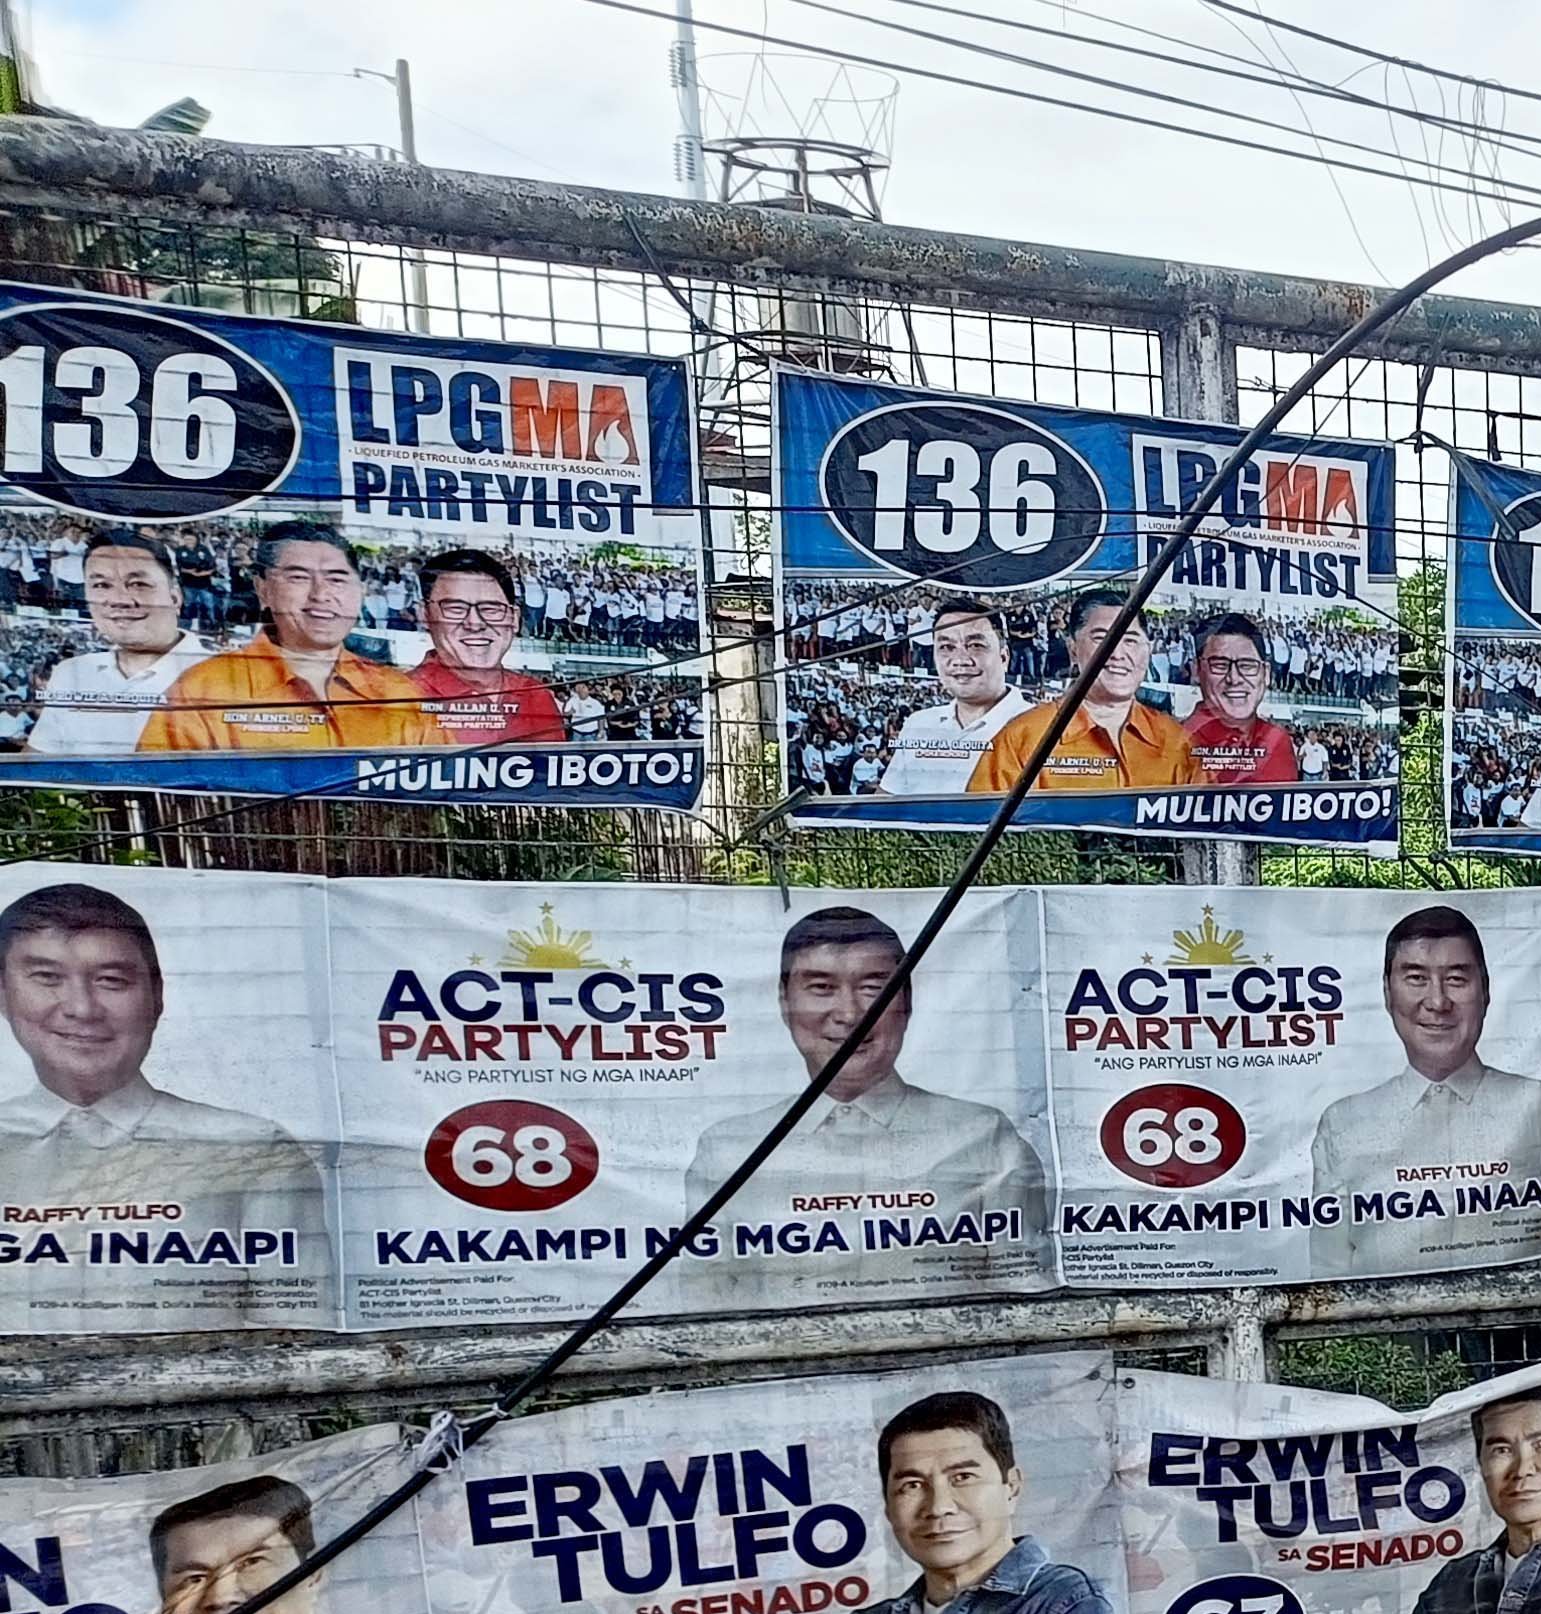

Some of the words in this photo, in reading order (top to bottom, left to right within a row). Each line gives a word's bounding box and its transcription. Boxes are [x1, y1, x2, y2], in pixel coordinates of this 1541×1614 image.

[0, 344, 239, 481] 136
[347, 358, 640, 466] LPGMA
[354, 447, 410, 460] LIQUEFIED
[413, 452, 477, 465] PETROLEUM
[479, 458, 500, 468] GAS
[502, 459, 567, 473] MARKETER'S
[568, 464, 636, 478] ASSOCIATION
[352, 461, 641, 535] PARTYLIST
[857, 439, 1058, 555] 136
[1142, 445, 1360, 540] LPGMA
[357, 753, 535, 793] MULING
[547, 752, 694, 789] IBOTO!
[1136, 791, 1273, 825] MULING
[1283, 788, 1390, 821] IBOTO!
[378, 969, 724, 1023] ACT-CIS
[1066, 966, 1341, 1017] ACT-CIS
[378, 1023, 727, 1062] PARTYLIST
[1066, 1013, 1344, 1052] PARTYLIST
[468, 1069, 553, 1083] PARTYLIST
[560, 1069, 587, 1082] NG
[592, 1069, 634, 1082] MGA
[1140, 1056, 1212, 1070] PARTYLIST
[1217, 1055, 1239, 1068] NG
[1243, 1055, 1274, 1067] MGA
[451, 1125, 570, 1188] 68
[1123, 1107, 1222, 1166] 68
[1397, 1167, 1452, 1182] RAFFY
[1457, 1162, 1509, 1178] TULFO
[4, 1206, 92, 1223] RAFFY
[98, 1204, 182, 1221] TULFO
[793, 1195, 863, 1212] RAFFY
[868, 1192, 935, 1208] TULFO
[1063, 1201, 1268, 1233] KAKAMPI
[1283, 1197, 1340, 1227] NG
[1353, 1189, 1445, 1222] MGA
[90, 1231, 296, 1264] INAAPI
[376, 1229, 625, 1264] KAKAMPI
[735, 1221, 849, 1256] MGA
[864, 1210, 1019, 1250] INAAPI
[465, 1443, 813, 1546] ERWIN
[1201, 1467, 1465, 1542] TULFO
[531, 1503, 868, 1603] TULFO
[1278, 1547, 1301, 1562] SA
[1306, 1529, 1463, 1572] SENADO
